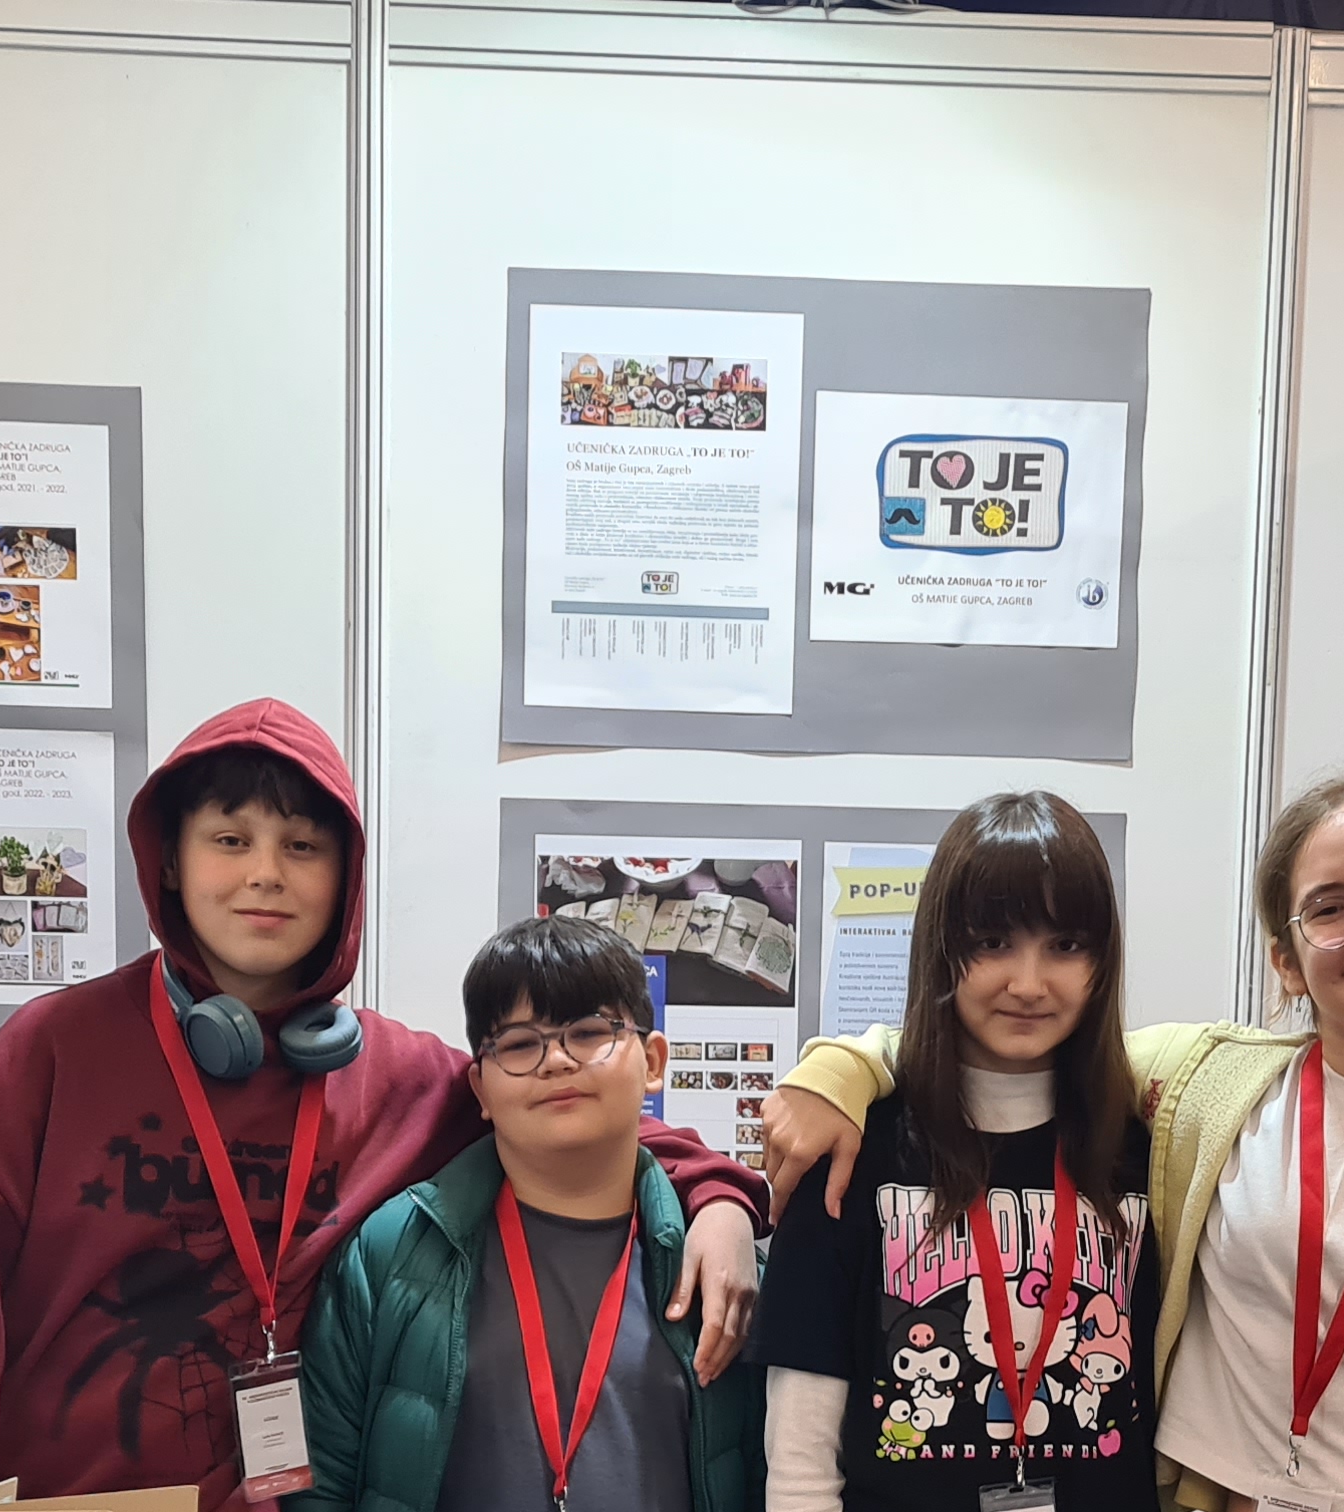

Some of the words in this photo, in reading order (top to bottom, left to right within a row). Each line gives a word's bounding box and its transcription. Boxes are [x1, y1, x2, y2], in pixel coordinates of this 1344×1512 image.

[29, 443, 71, 453] ZADRUGA
[566, 442, 626, 455] UČENIČKA
[628, 445, 684, 457] ZADRUGA
[711, 447, 726, 458] JE
[0, 452, 8, 461] JE
[566, 460, 581, 472] OŠ
[584, 461, 617, 475] Matije
[618, 463, 654, 476] Gupca,
[656, 464, 692, 476] Zagreb
[898, 449, 975, 491] TO
[982, 452, 1045, 492] JE
[940, 497, 1030, 538] TO!
[645, 573, 661, 583] TO
[662, 574, 675, 583] JE
[898, 574, 944, 587] UČENIČKA
[947, 576, 993, 587] ZADRUGA
[1015, 578, 1024, 588] JE
[654, 582, 672, 592] TO!
[911, 593, 925, 604] OŠ
[926, 594, 958, 605] MATIJE
[960, 594, 995, 606] GUPCA,
[997, 596, 1033, 607] ZAGREB
[36, 750, 77, 759] ZADRUGA
[7, 760, 15, 768] JE
[4, 769, 32, 778] MATIJE
[850, 882, 922, 899] POP-U
[839, 928, 896, 936] INTERAKTIVNA
[920, 1444, 976, 1459] AND
